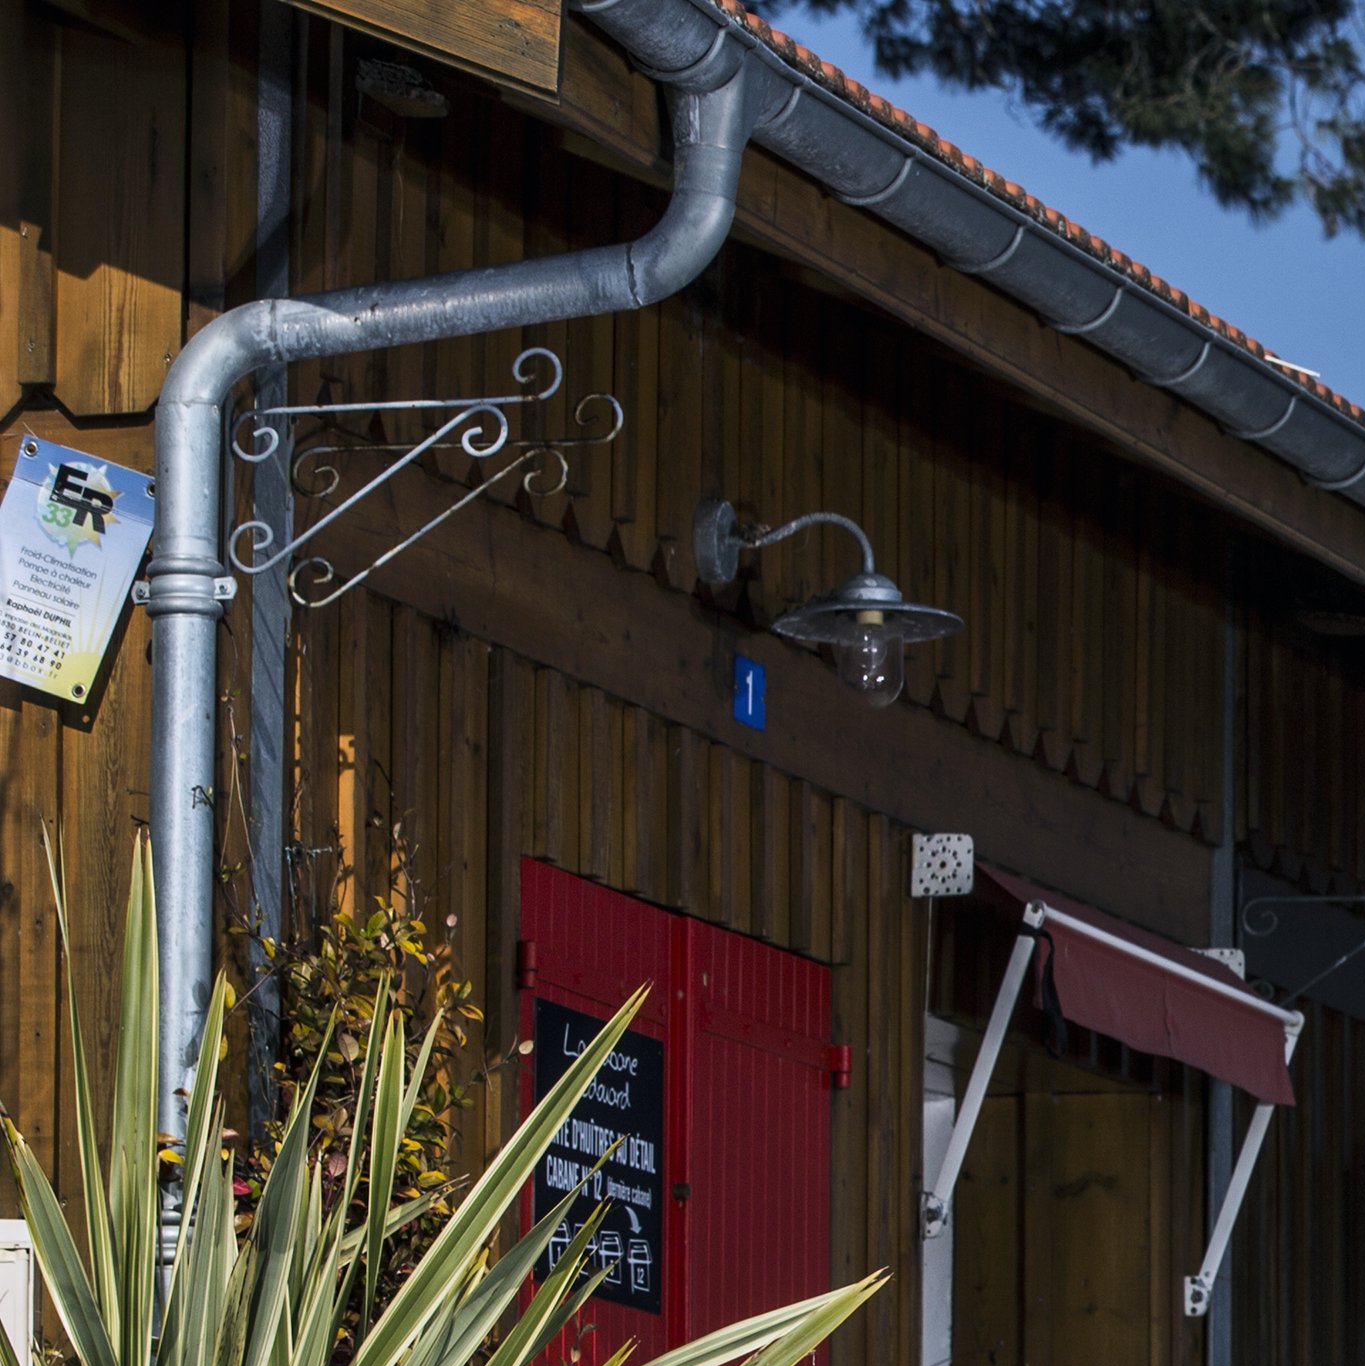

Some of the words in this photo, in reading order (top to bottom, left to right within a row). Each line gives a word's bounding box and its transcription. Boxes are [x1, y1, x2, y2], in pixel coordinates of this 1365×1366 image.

[50, 463, 114, 534] ER
[42, 502, 73, 528] 33
[18, 557, 49, 576] Pompe
[58, 573, 92, 589] chaleur
[20, 545, 98, 580] Froid-Climatisation
[6, 598, 43, 618] Raphaël
[12, 580, 51, 600] Panneau
[53, 595, 80, 610] solaire
[4, 631, 16, 641] 57
[20, 637, 33, 648] 80
[37, 643, 50, 653] 47
[53, 649, 66, 660] 41
[15, 648, 29, 658] 39
[32, 655, 46, 665] 68
[50, 660, 63, 671] 90
[745, 670, 755, 716] 1
[629, 1132, 656, 1175] DÉTAIL
[546, 1154, 580, 1193] CABANE
[636, 1267, 646, 1285] 12
